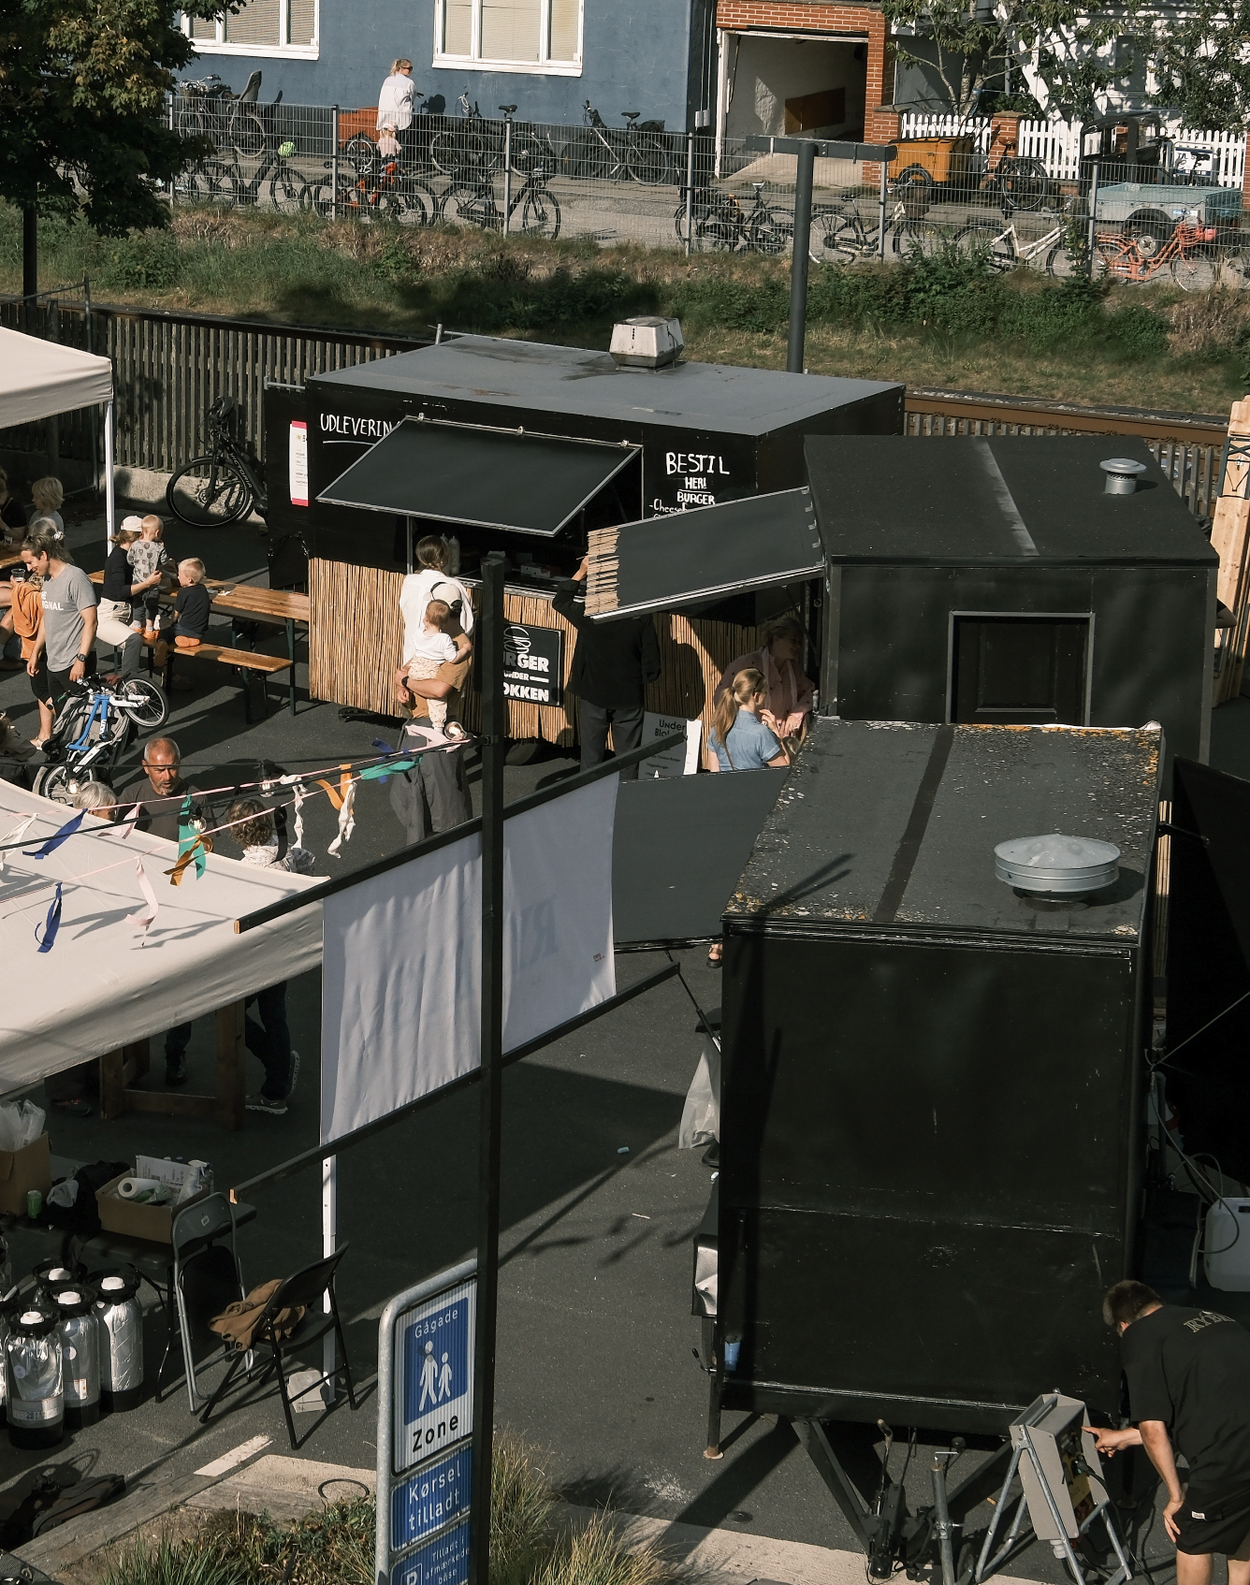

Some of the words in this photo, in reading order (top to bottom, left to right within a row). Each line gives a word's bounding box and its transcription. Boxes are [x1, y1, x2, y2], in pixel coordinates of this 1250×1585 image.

[320, 413, 401, 437] UDLEVERIN
[666, 452, 730, 475] BESTIL
[685, 476, 707, 490] HER!
[677, 491, 716, 506] BURGER
[503, 651, 549, 673] RGER
[415, 1309, 458, 1339] Gågade
[412, 1415, 458, 1453] Zone
[409, 1460, 460, 1505] Kørsel
[408, 1488, 460, 1531] tilladt
[432, 1540, 458, 1562] Tilladt
